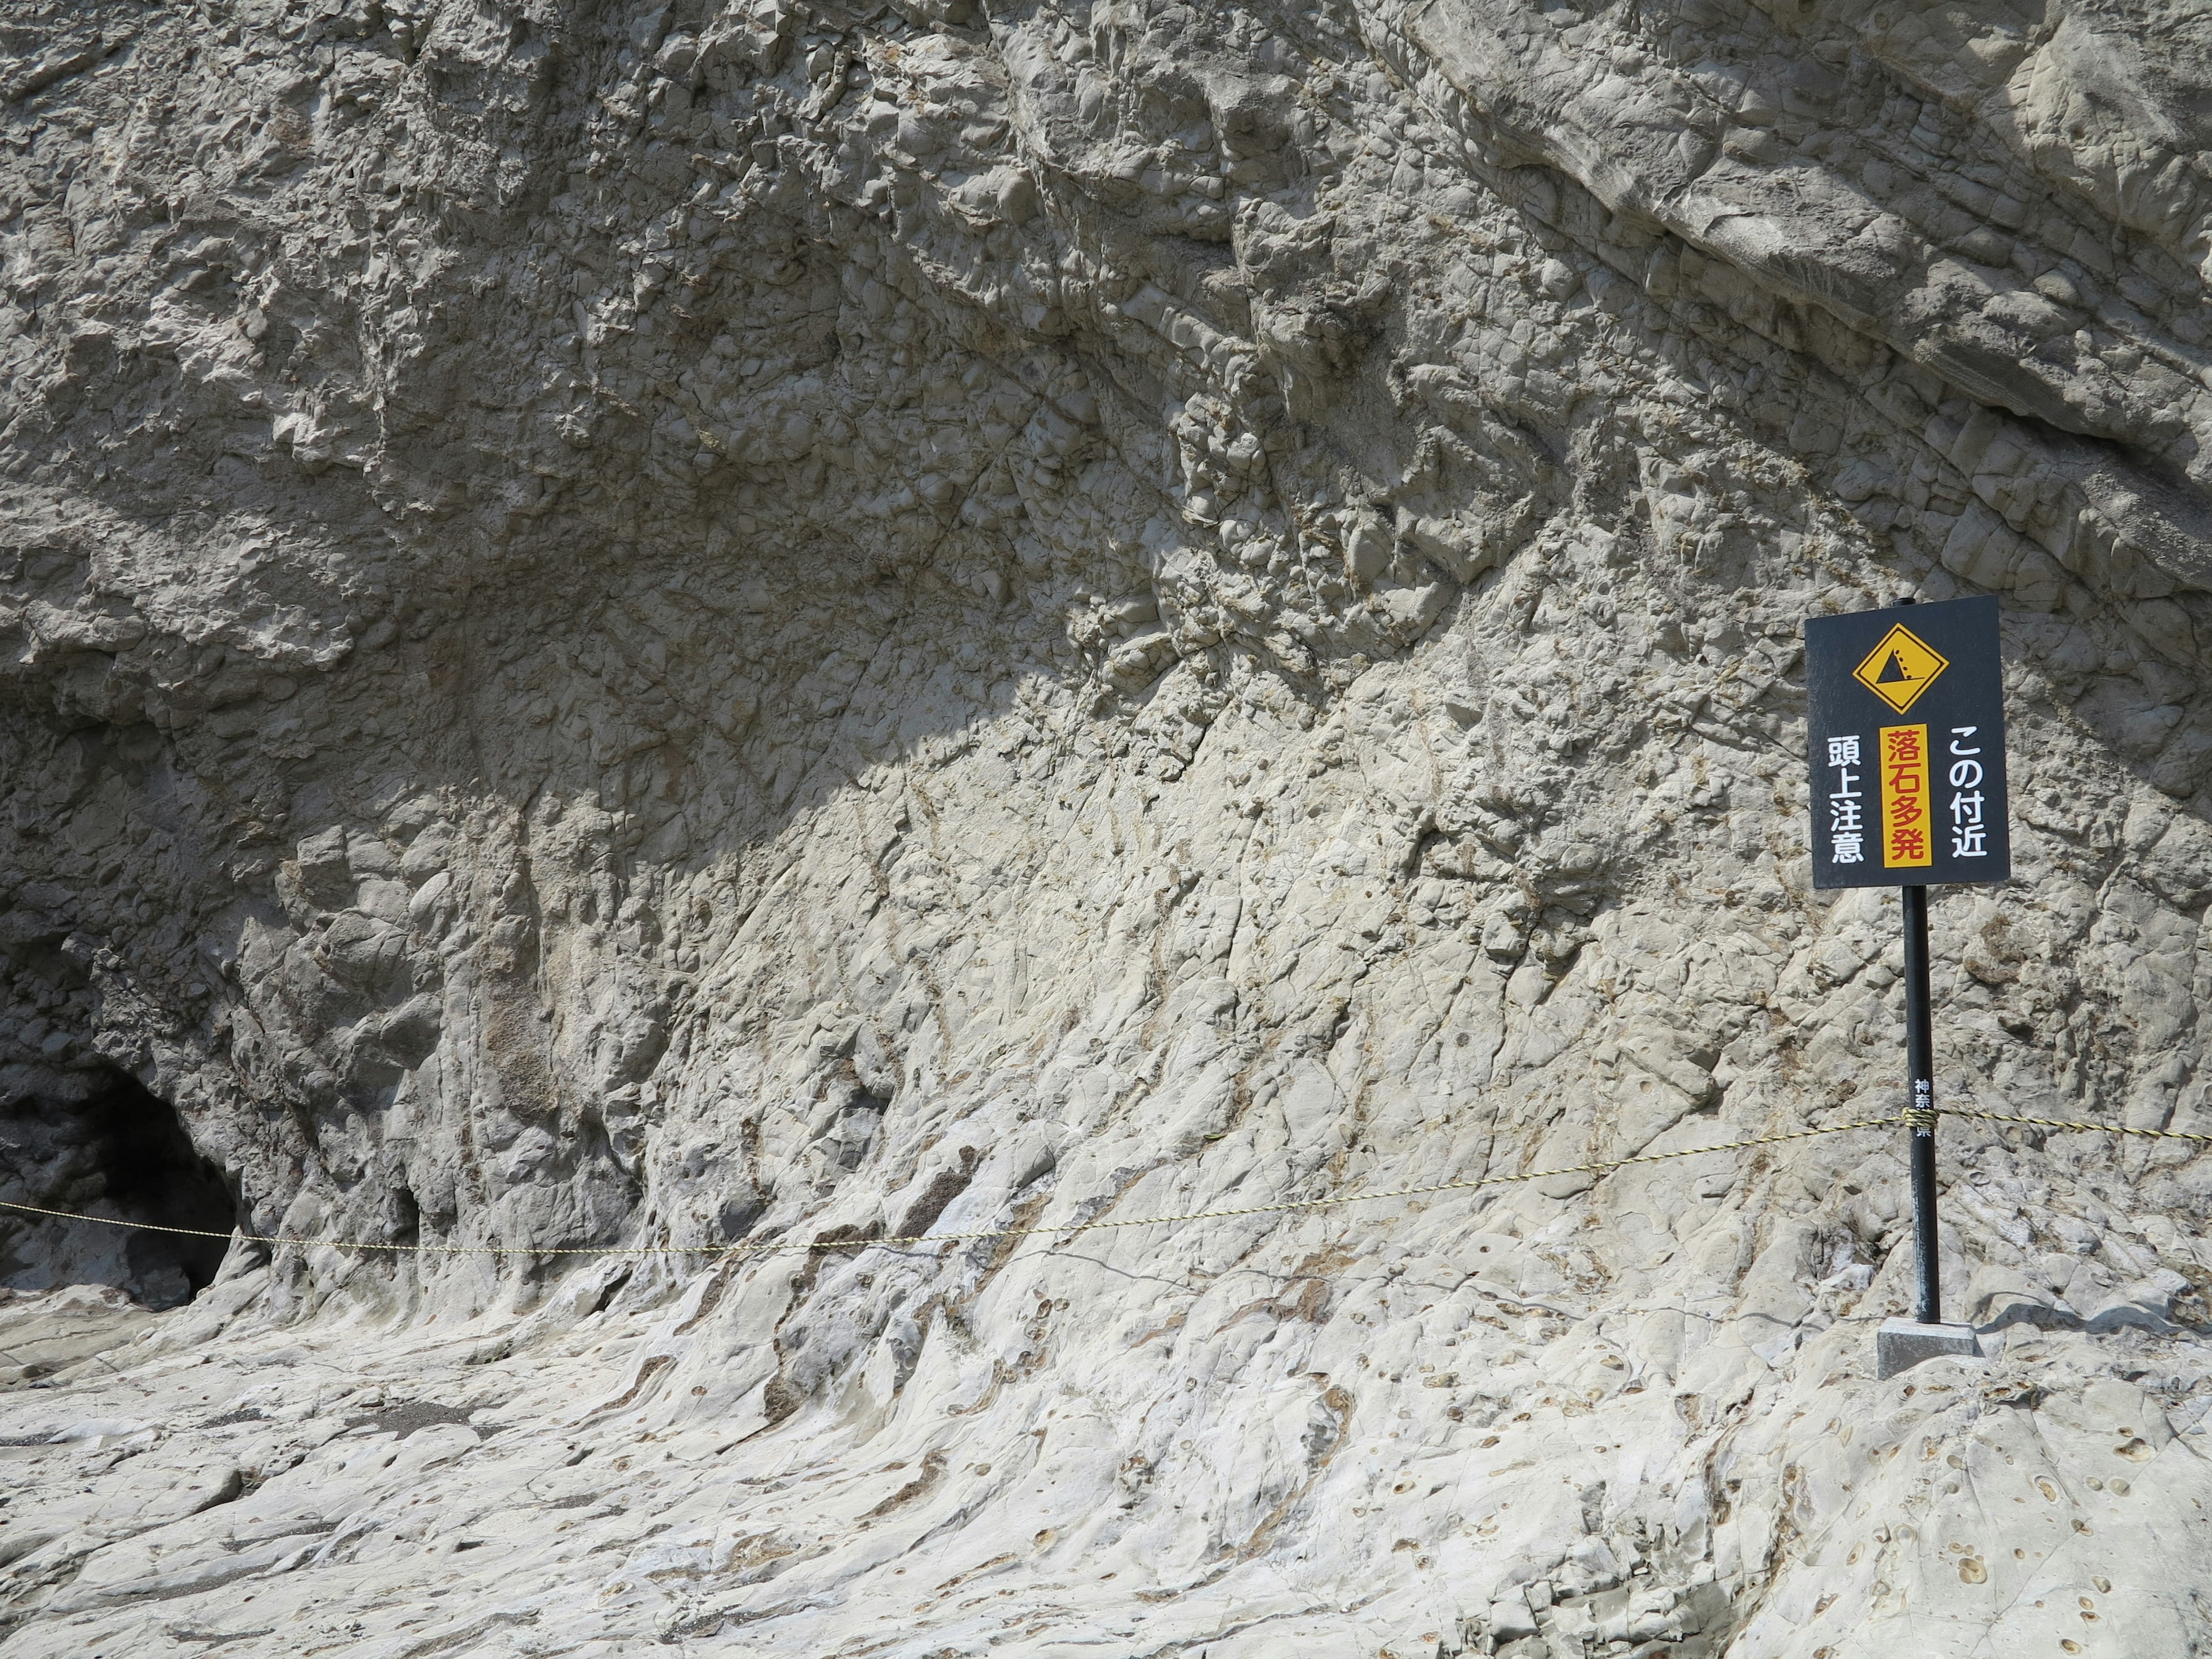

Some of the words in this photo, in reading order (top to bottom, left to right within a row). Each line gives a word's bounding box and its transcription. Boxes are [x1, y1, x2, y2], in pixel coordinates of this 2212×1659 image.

[1827, 734, 1865, 863] 頭上注意
[1887, 729, 1924, 861] 落石多発
[1949, 725, 1988, 858] この付近
[1915, 1078, 1931, 1138] 神奈県
